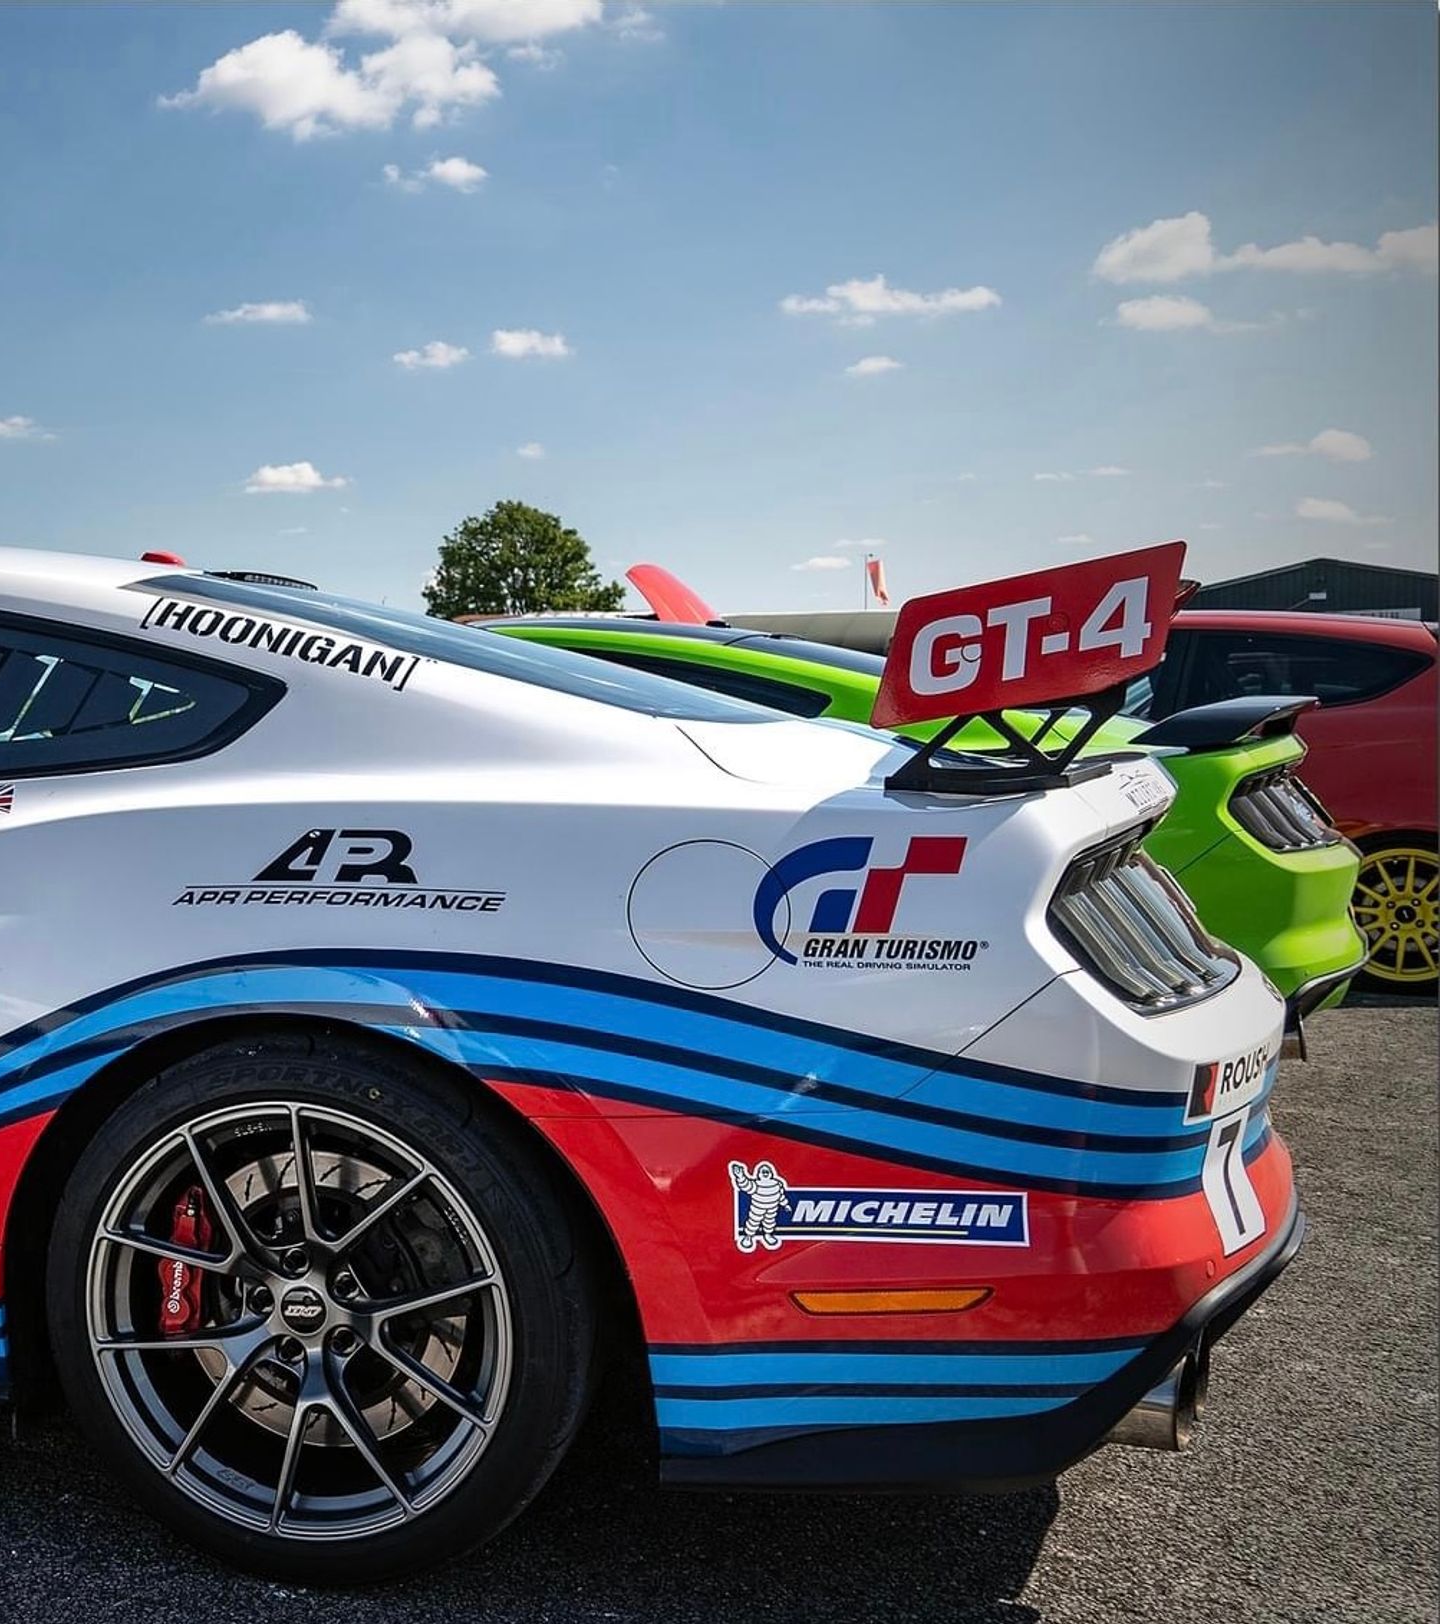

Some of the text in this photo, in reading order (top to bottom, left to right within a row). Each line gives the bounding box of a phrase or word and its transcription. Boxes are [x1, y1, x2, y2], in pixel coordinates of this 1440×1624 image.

[910, 576, 1152, 696] GT-4
[172, 891, 507, 913] APR PERFORMANCE
[803, 938, 868, 959] GRAN
[857, 962, 902, 970] DRIVING
[906, 963, 971, 971] SIMULATOR
[1217, 1118, 1246, 1236] 7
[791, 1199, 1013, 1228] MICHELIN
[172, 1260, 184, 1300] bremb
